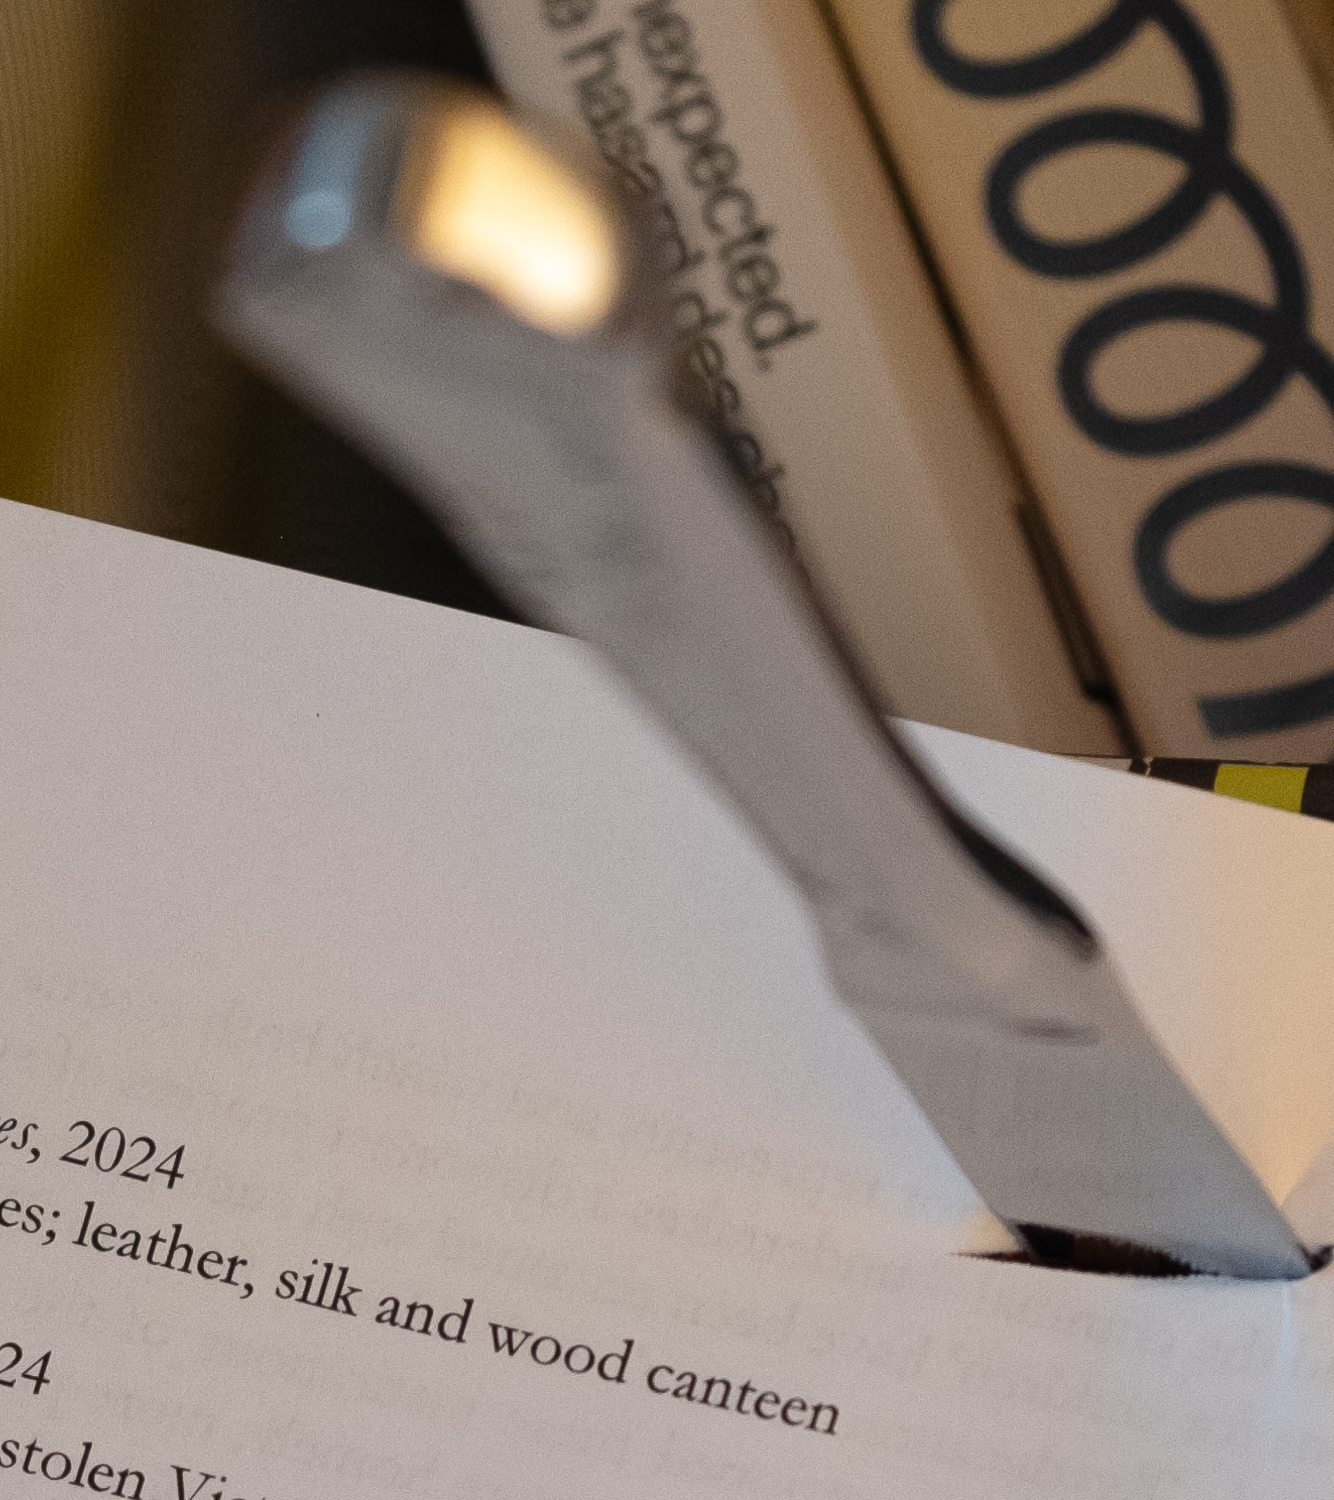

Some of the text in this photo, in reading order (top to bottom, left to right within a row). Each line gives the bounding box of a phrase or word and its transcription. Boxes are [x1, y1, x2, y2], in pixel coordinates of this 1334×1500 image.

[57, 1118, 187, 1192] 2024
[70, 1198, 256, 1302] leather,
[273, 1256, 364, 1319] silk
[372, 1294, 477, 1346] and
[487, 1320, 637, 1386] wood
[644, 1363, 842, 1438] canteen
